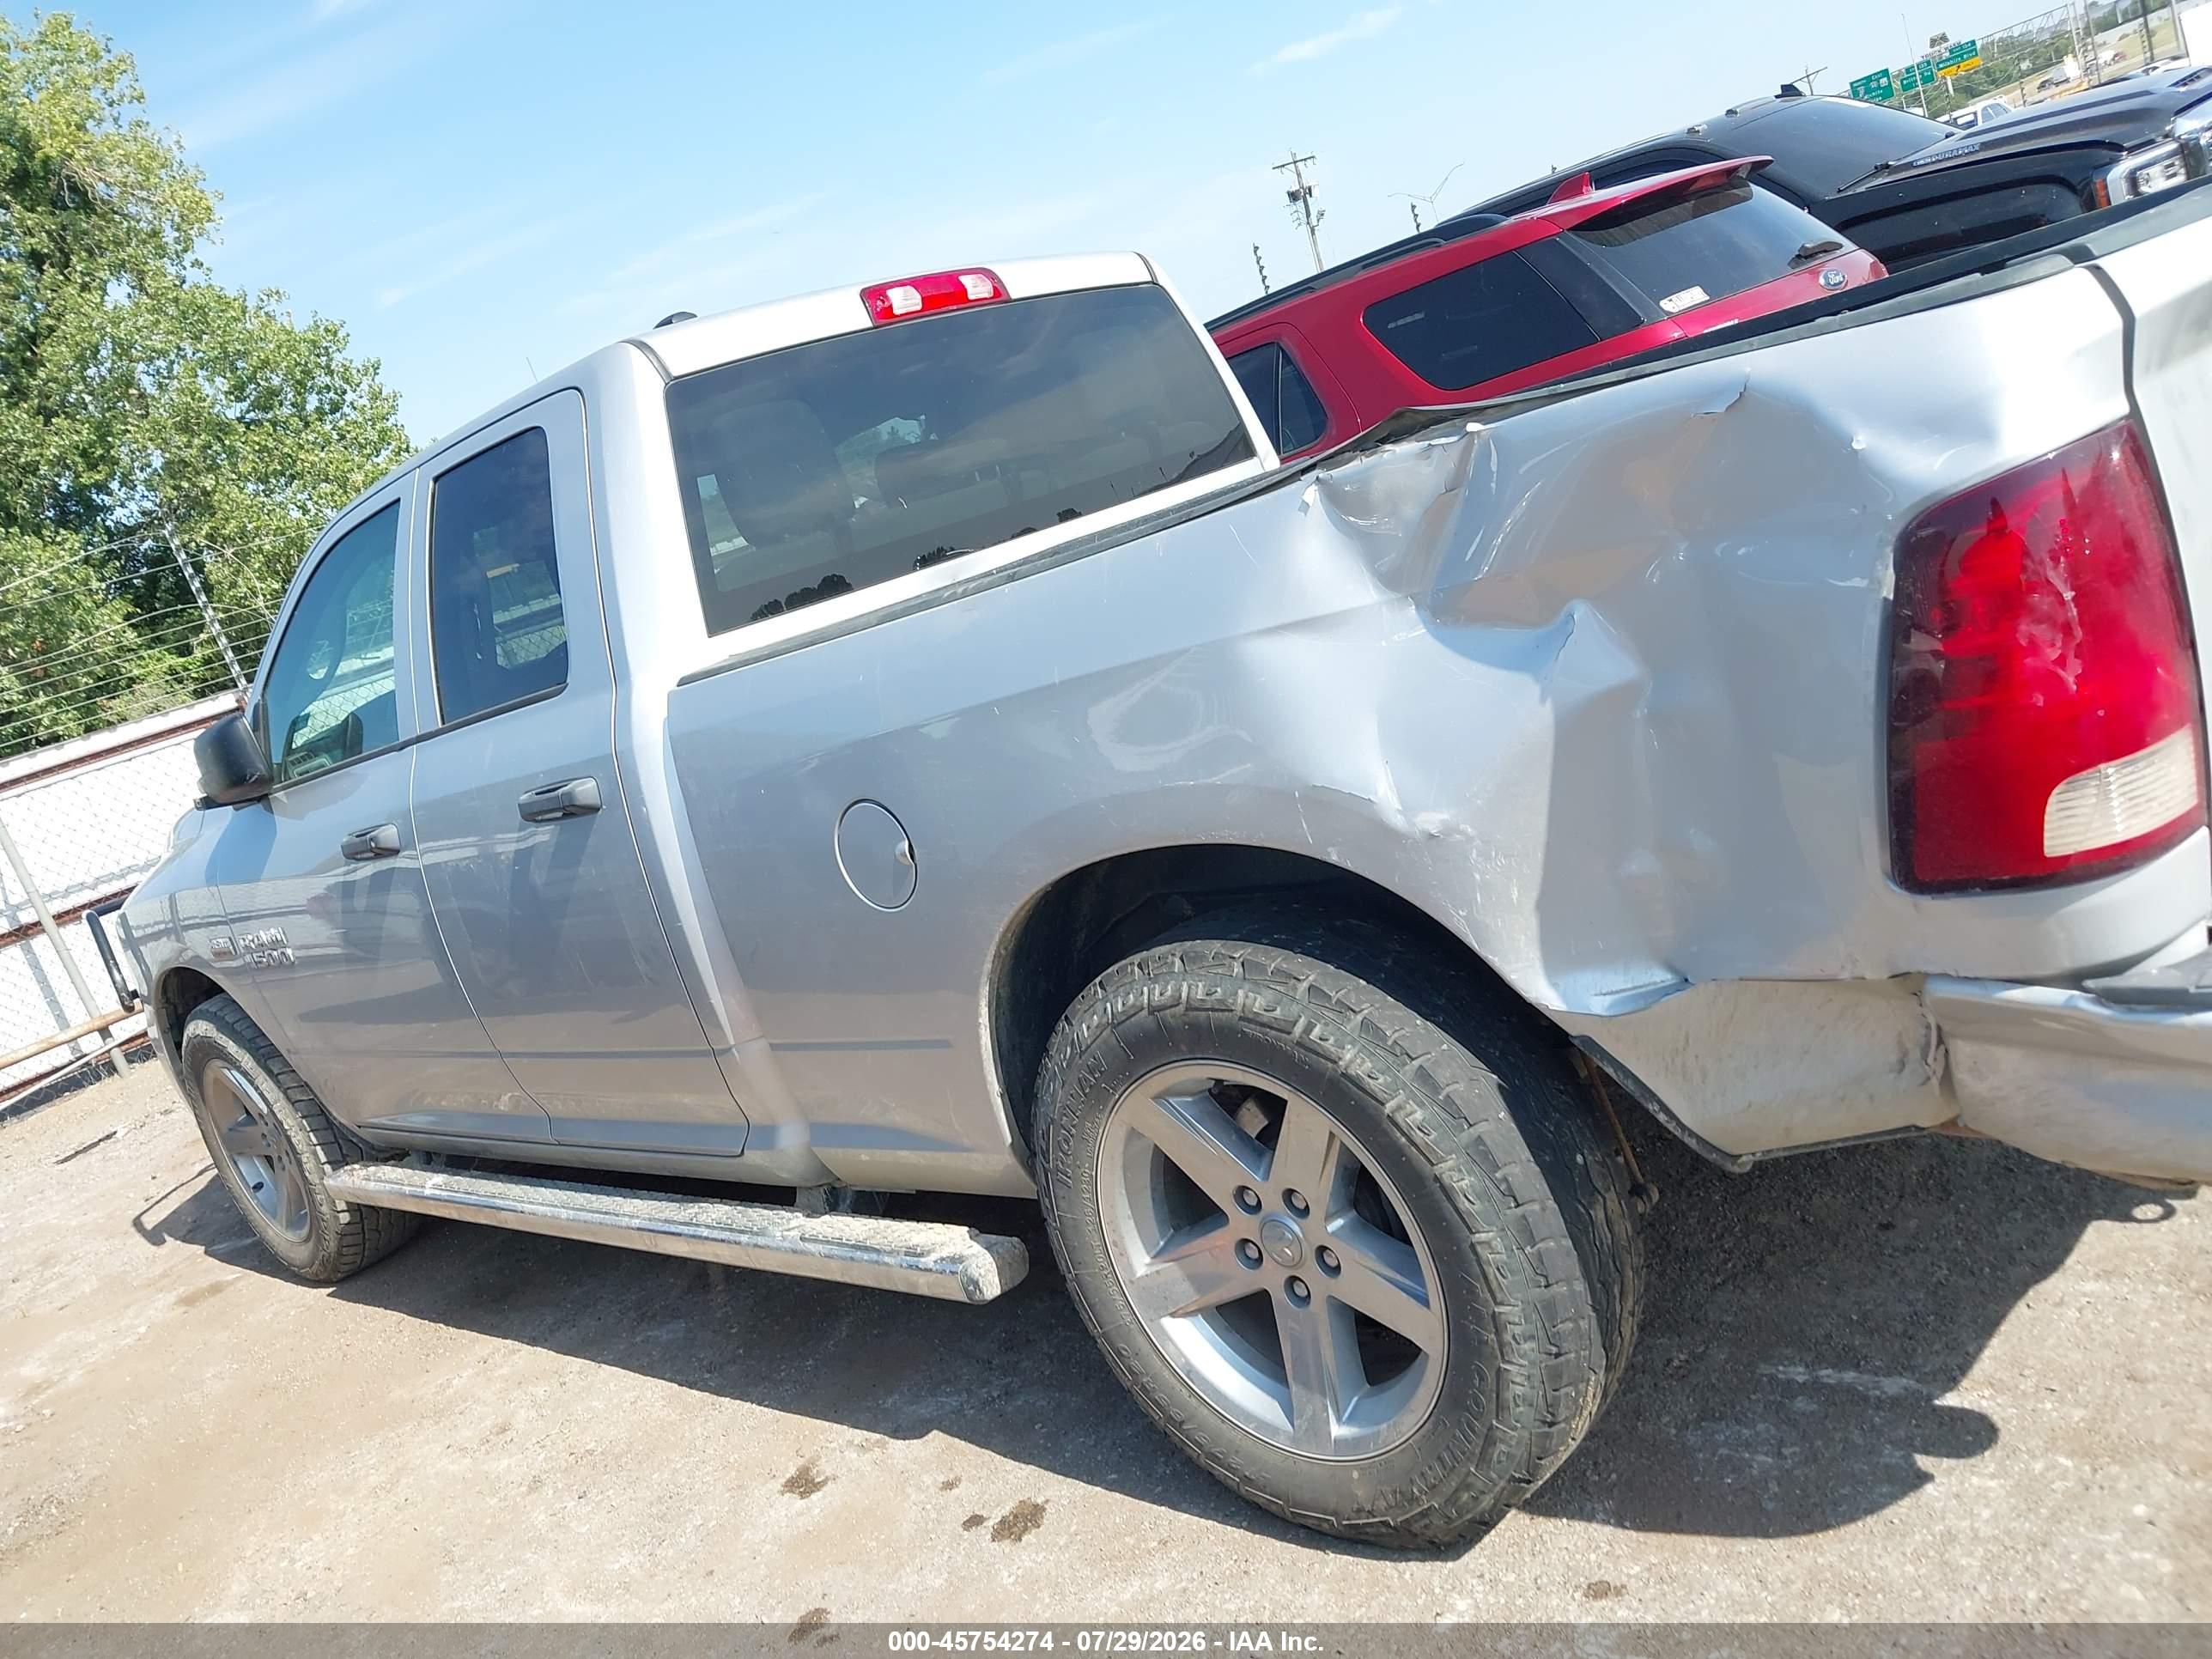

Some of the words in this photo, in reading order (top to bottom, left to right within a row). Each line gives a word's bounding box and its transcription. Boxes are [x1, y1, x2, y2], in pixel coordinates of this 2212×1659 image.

[1931, 143, 1981, 161] DURAMAX
[1827, 270, 1844, 285] Ford
[238, 927, 289, 954] RAM
[244, 948, 296, 969] 1500
[1055, 1050, 1109, 1189] IRONMAN
